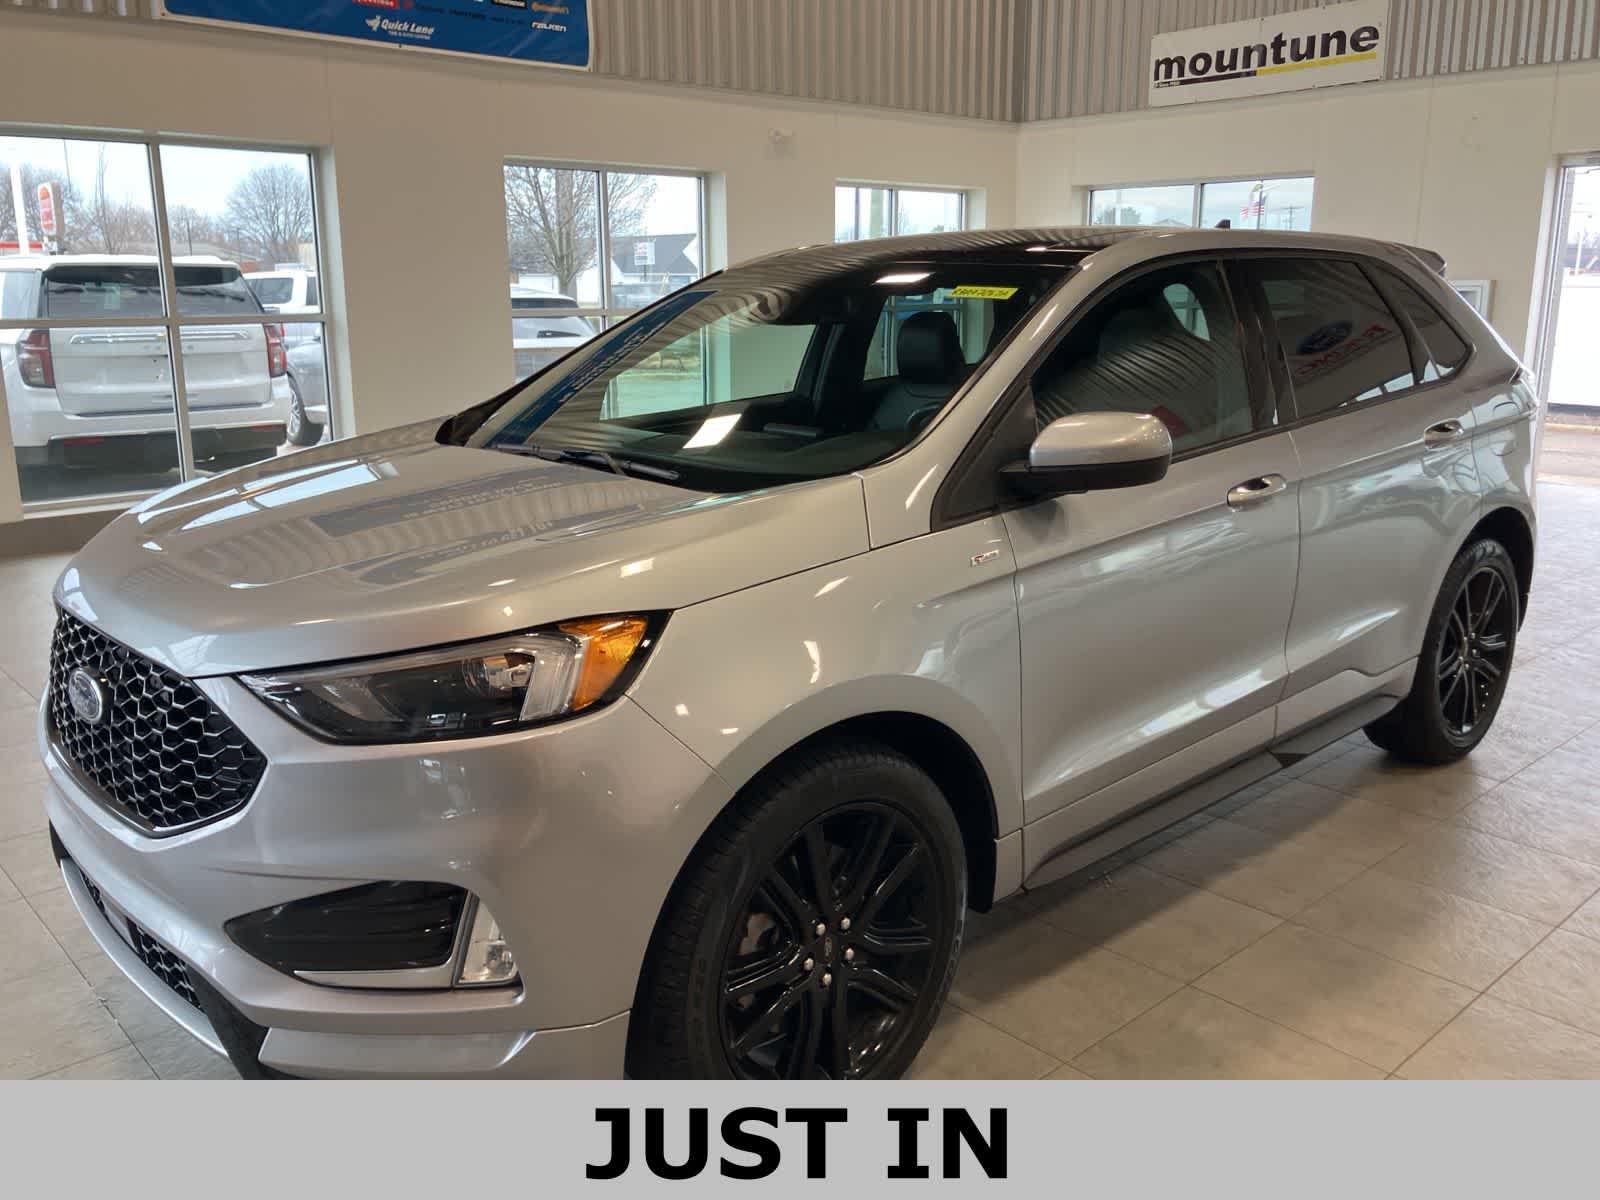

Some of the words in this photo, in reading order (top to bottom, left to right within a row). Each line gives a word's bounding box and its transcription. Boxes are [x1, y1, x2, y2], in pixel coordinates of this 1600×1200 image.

[381, 18, 410, 32] Quick
[410, 23, 435, 35] Lane
[1153, 25, 1380, 82] mountune
